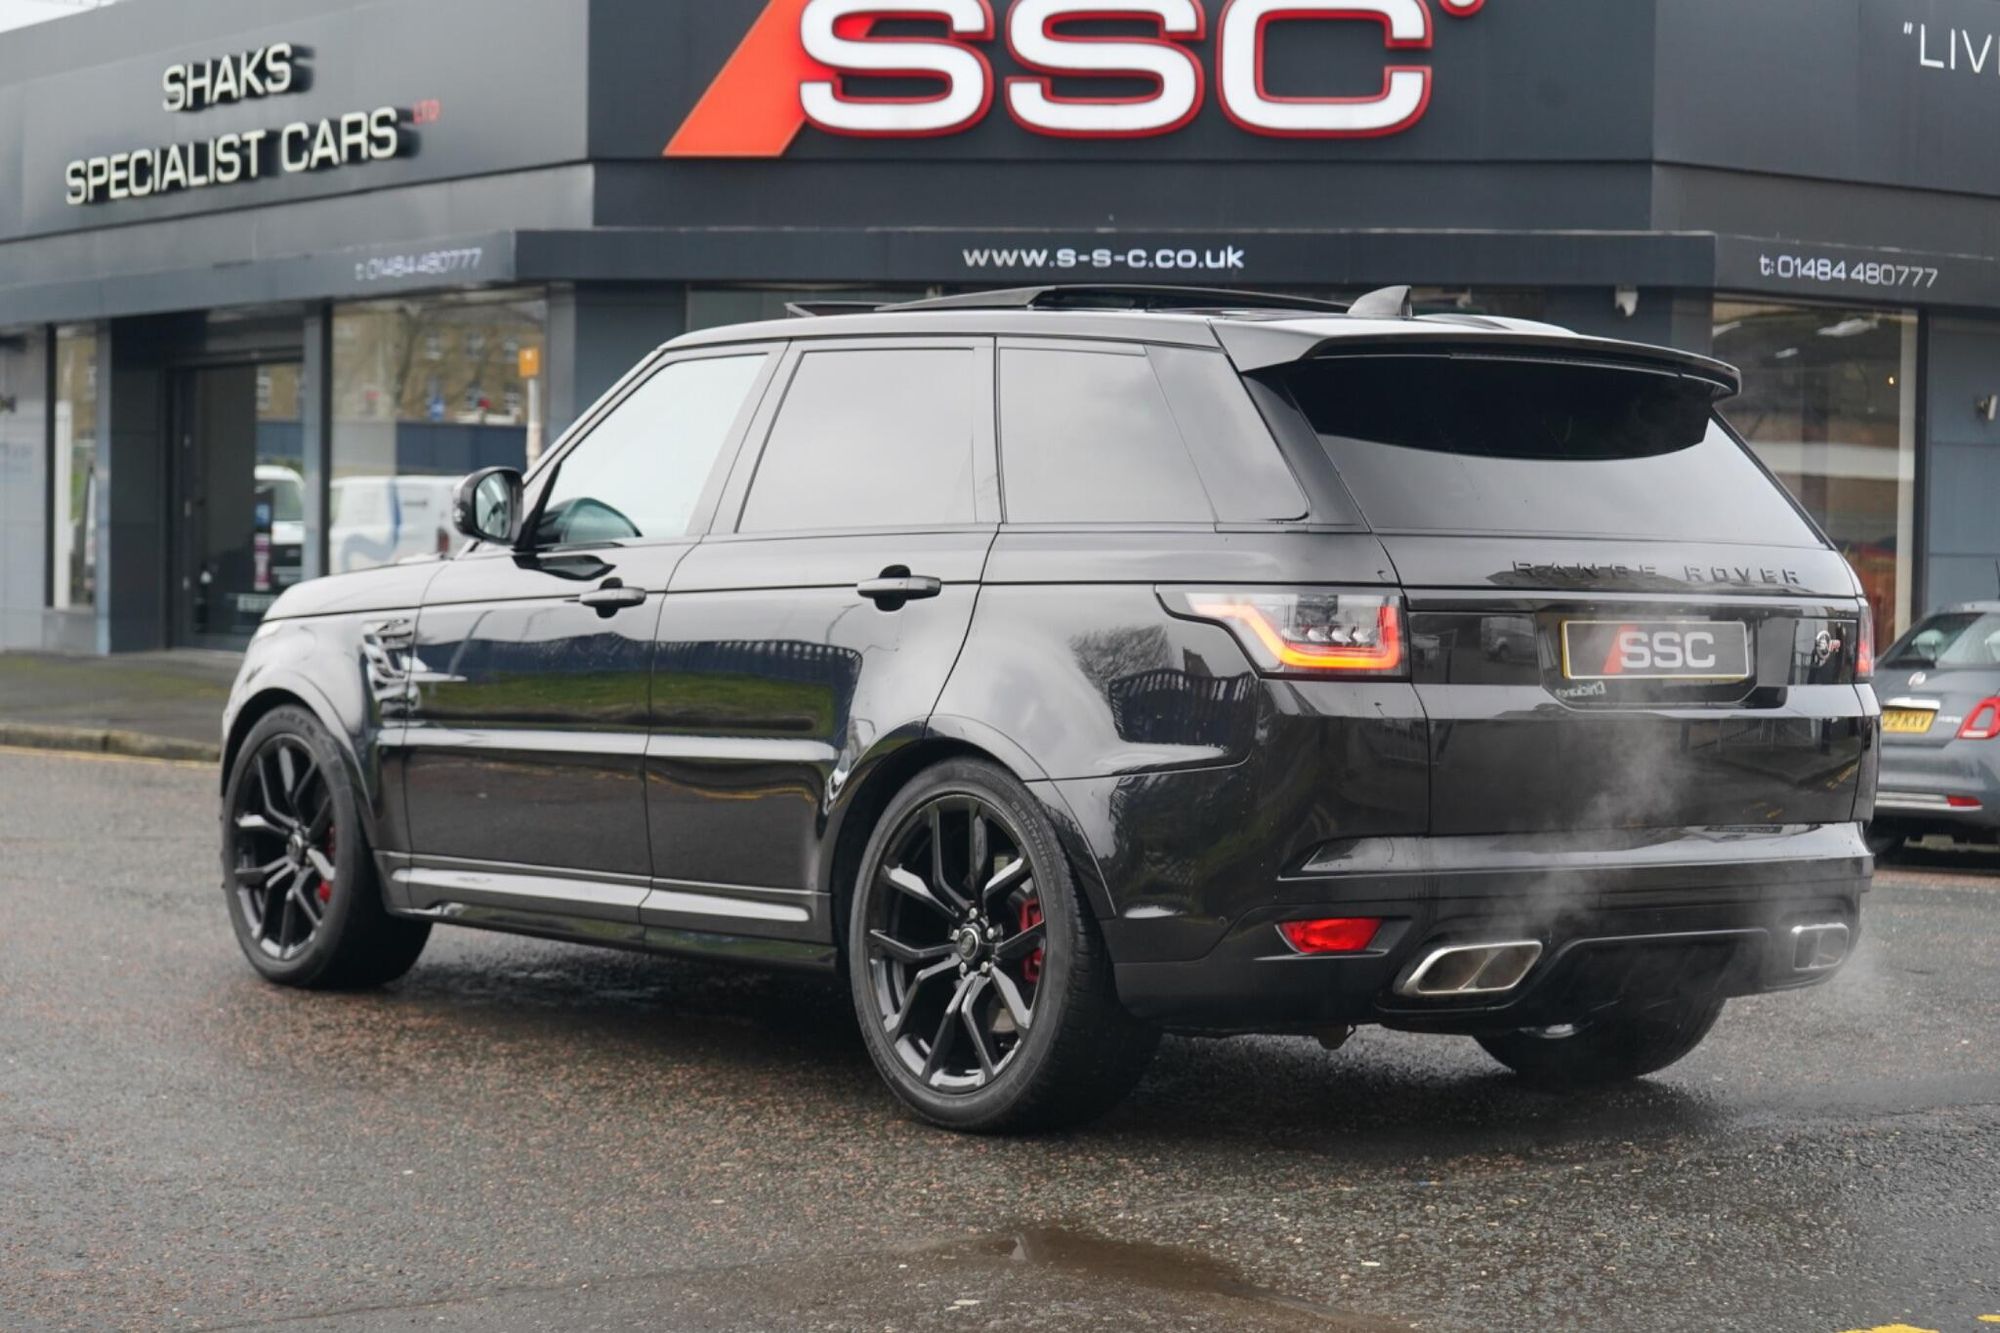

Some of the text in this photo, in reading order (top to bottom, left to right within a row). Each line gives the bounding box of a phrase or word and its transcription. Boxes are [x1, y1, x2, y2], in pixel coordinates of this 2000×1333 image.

[799, 0, 1433, 138] SSC
[1903, 21, 2000, 76] "LIV
[163, 43, 292, 112] SHAKS
[65, 129, 266, 206] SPECIALIST
[280, 106, 398, 173] CARS
[962, 245, 1245, 270] www.s-s-c.co.uk
[1683, 565, 1800, 585] ROVER
[1618, 631, 1717, 669] SSC
